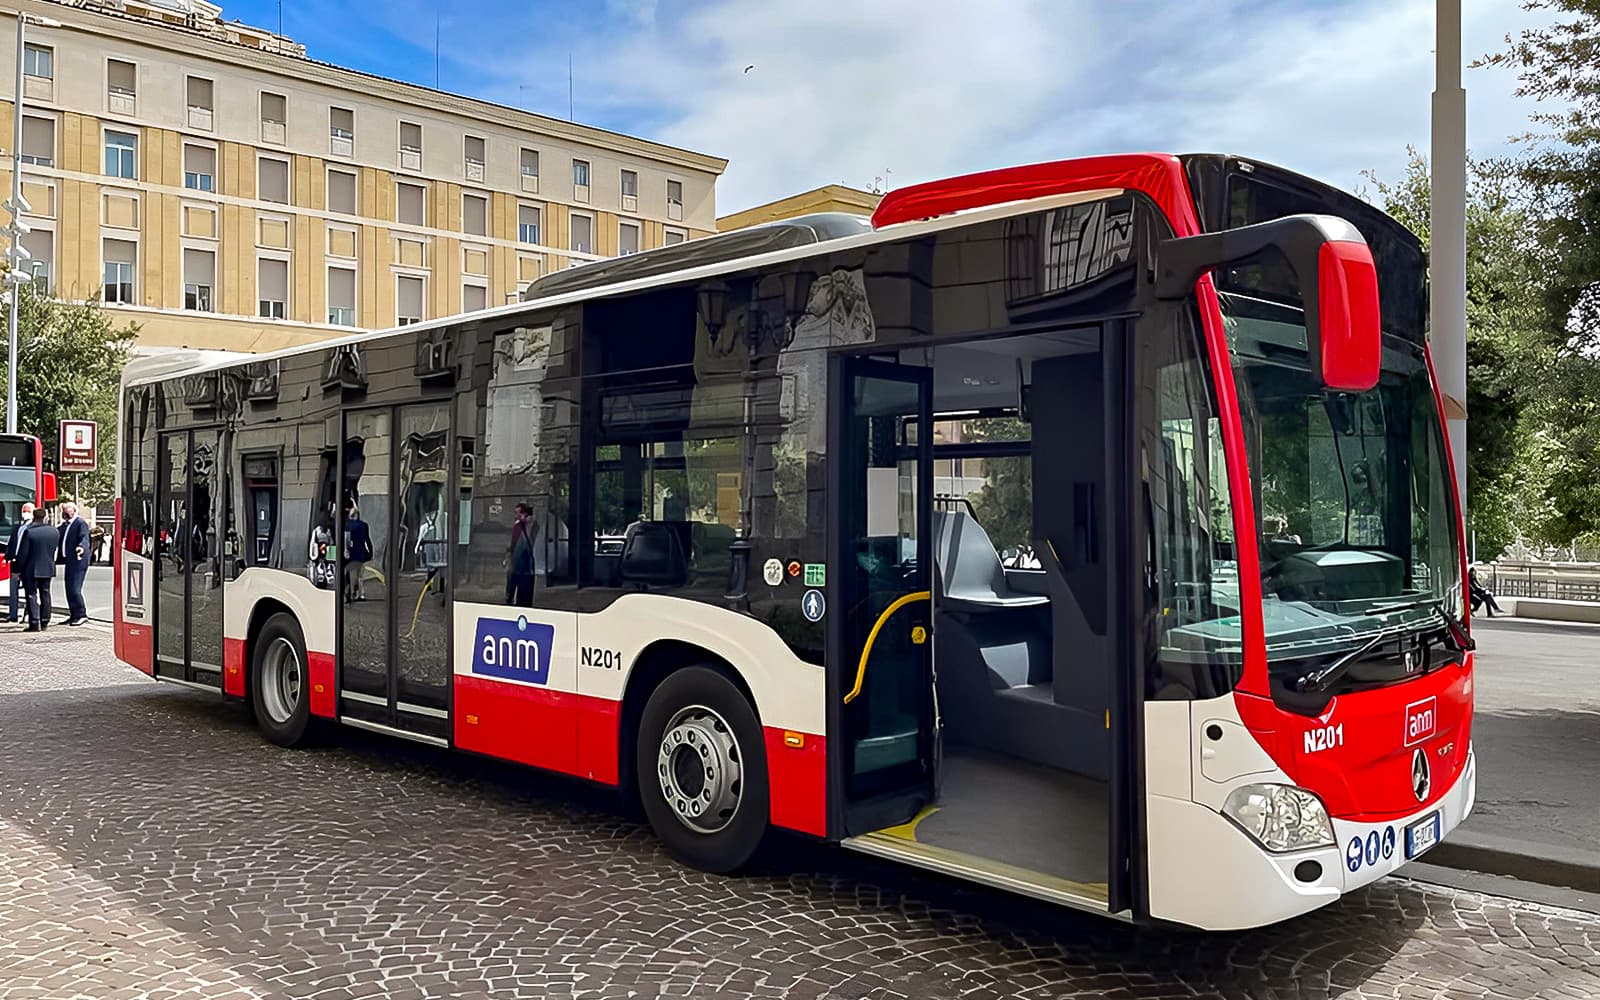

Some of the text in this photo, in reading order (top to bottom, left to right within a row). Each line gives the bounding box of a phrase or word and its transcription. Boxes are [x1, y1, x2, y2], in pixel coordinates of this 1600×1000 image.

[482, 634, 539, 672] anm
[581, 646, 622, 671] N201
[1303, 723, 1344, 754] N201
[1409, 709, 1433, 738] anm
